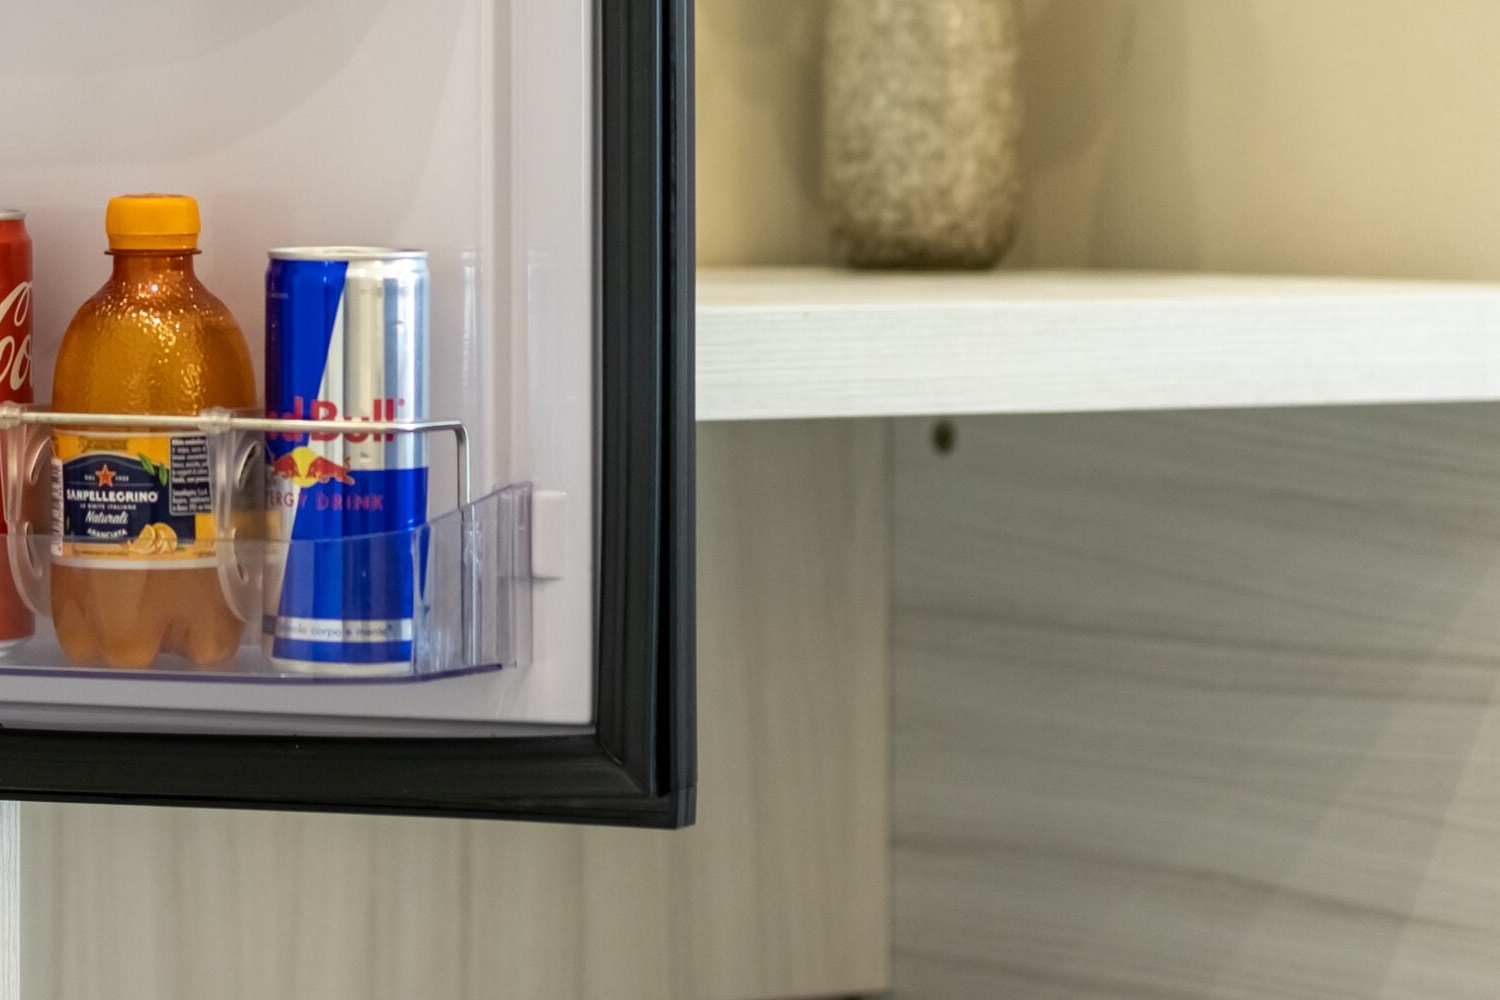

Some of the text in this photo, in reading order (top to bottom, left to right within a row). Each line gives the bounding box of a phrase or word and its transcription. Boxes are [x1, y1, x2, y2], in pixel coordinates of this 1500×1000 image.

[66, 489, 159, 503] SANPELLEGRINO
[315, 493, 384, 511] DRINK
[85, 510, 129, 525] Naturali
[87, 528, 128, 540] ARANCIATA
